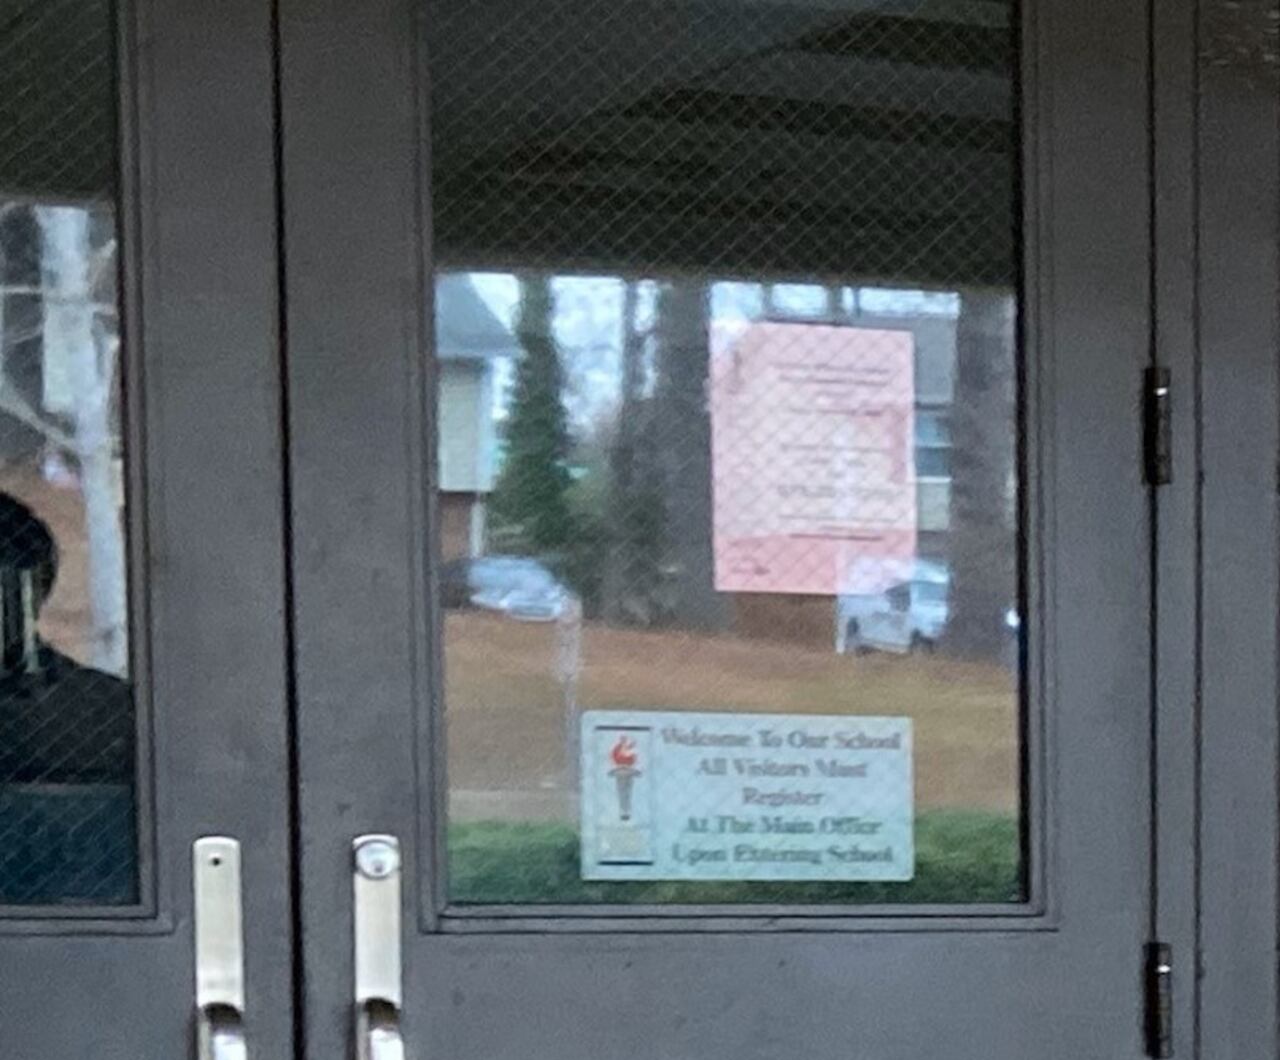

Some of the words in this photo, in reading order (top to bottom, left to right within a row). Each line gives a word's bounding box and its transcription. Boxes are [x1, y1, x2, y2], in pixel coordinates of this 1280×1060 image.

[662, 728, 751, 747] Welcome
[758, 730, 783, 748] To
[788, 730, 829, 748] Our
[834, 731, 901, 749] School
[700, 758, 727, 776] All
[734, 758, 810, 777] Visitors
[815, 759, 867, 777] Must
[743, 787, 824, 807] Register
[688, 816, 709, 834] At
[717, 816, 752, 834] The
[761, 816, 815, 834] Main
[820, 817, 883, 835] Office
[672, 844, 727, 866] Upon
[734, 845, 822, 864] Entering
[827, 845, 893, 863] School
